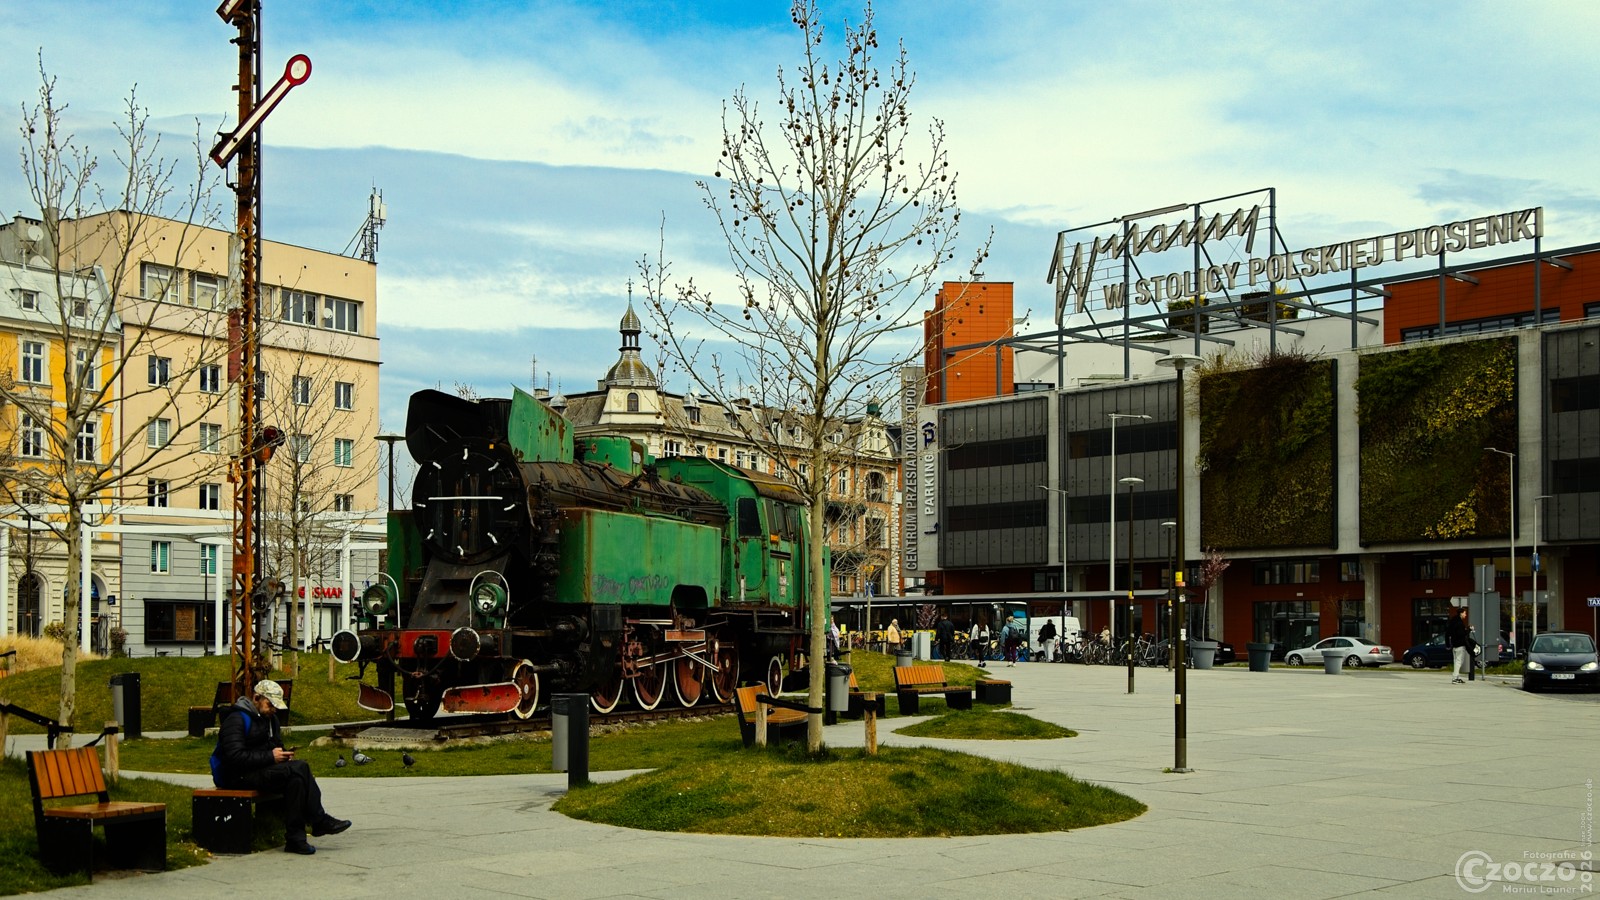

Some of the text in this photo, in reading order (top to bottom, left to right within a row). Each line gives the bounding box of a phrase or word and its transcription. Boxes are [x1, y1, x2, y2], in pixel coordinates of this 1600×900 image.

[1103, 206, 1544, 310] W STOLICY POLSKIEJ PIOSENKI
[906, 375, 917, 570] CENTRUM PRZESIADKOWE OPOLE
[924, 453, 935, 516] PARKING
